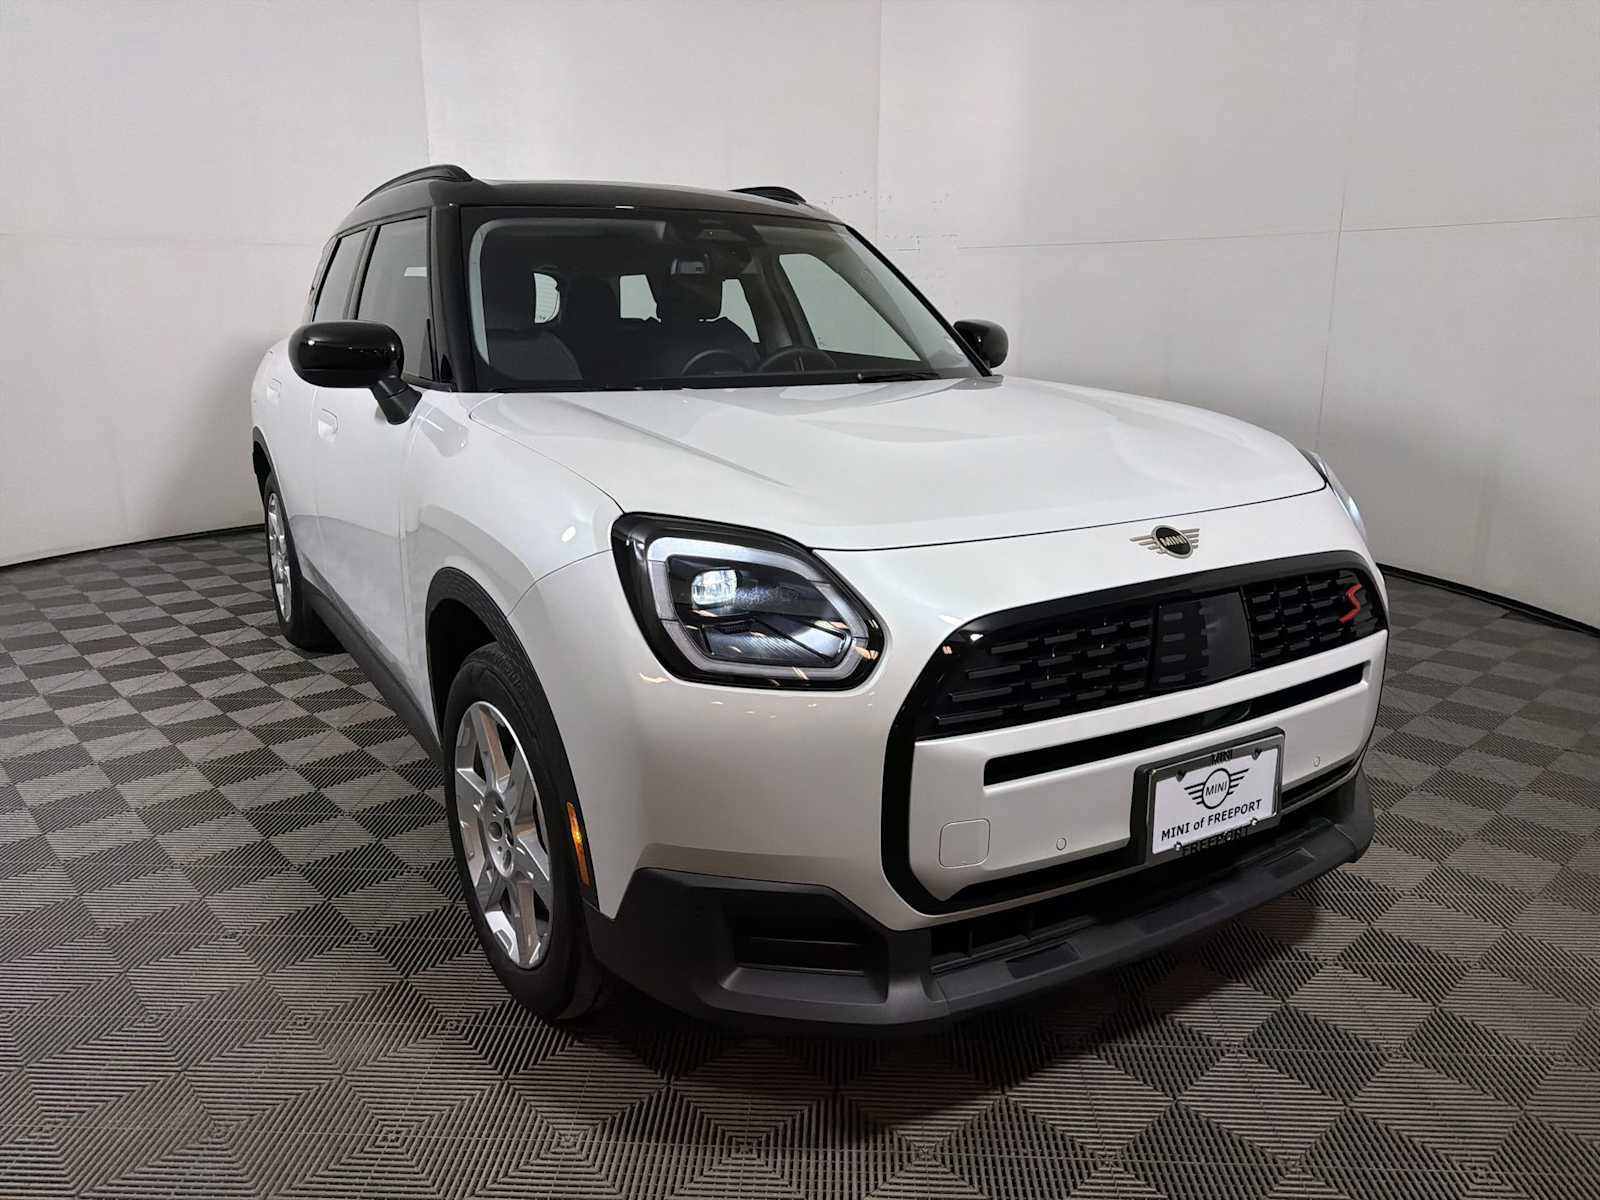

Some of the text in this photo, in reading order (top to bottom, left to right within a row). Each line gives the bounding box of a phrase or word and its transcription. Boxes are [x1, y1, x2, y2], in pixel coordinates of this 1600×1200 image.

[1339, 583, 1362, 624] S
[1211, 749, 1233, 765] MINI
[1205, 781, 1228, 797] MINI
[1161, 798, 1263, 841] MINI of FREEPORT
